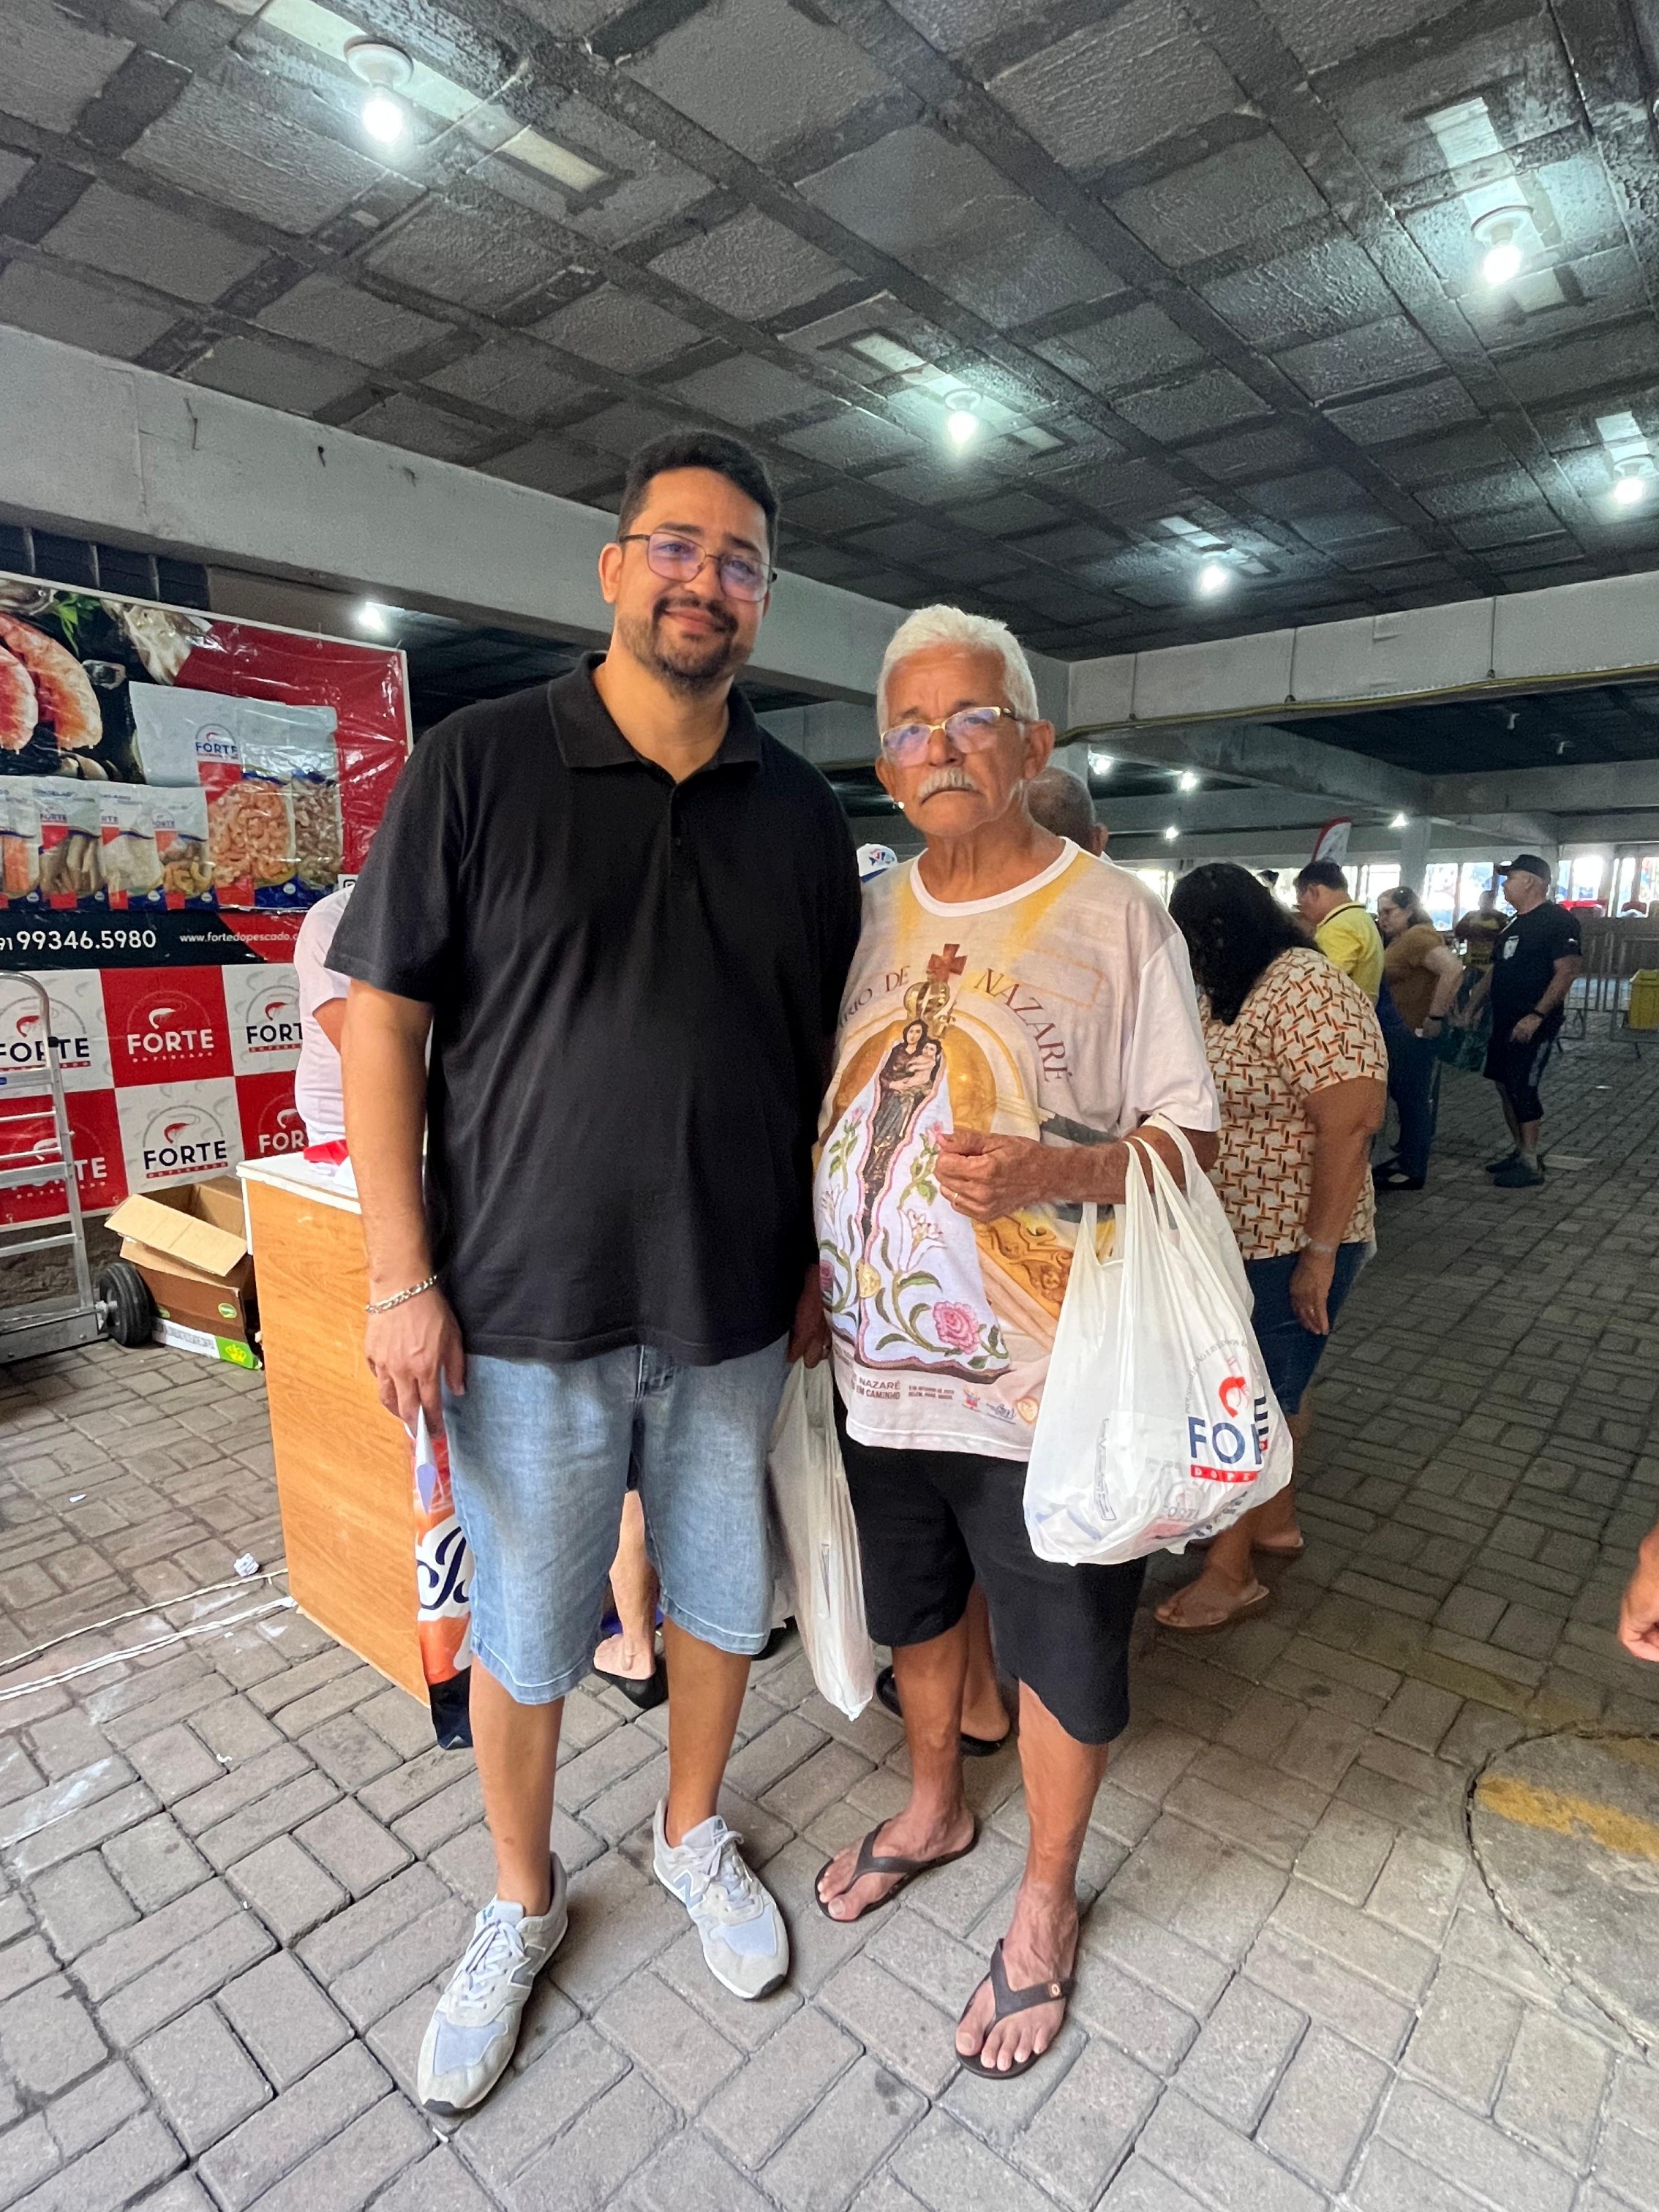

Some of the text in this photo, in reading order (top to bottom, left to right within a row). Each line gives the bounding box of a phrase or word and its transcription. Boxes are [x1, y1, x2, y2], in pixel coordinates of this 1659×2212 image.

[195, 742, 238, 756] FORTE
[0, 930, 157, 950] 91 99346.5980
[246, 1023, 304, 1045] FORT
[885, 965, 911, 993] DE
[974, 968, 1073, 1083] NAZARÉ
[127, 1028, 214, 1055] FORTE
[258, 1129, 306, 1154] FOR
[143, 1140, 227, 1170] FORTE
[859, 1377, 900, 1391] NAZARÉ
[866, 1389, 900, 1400] CAMINHO
